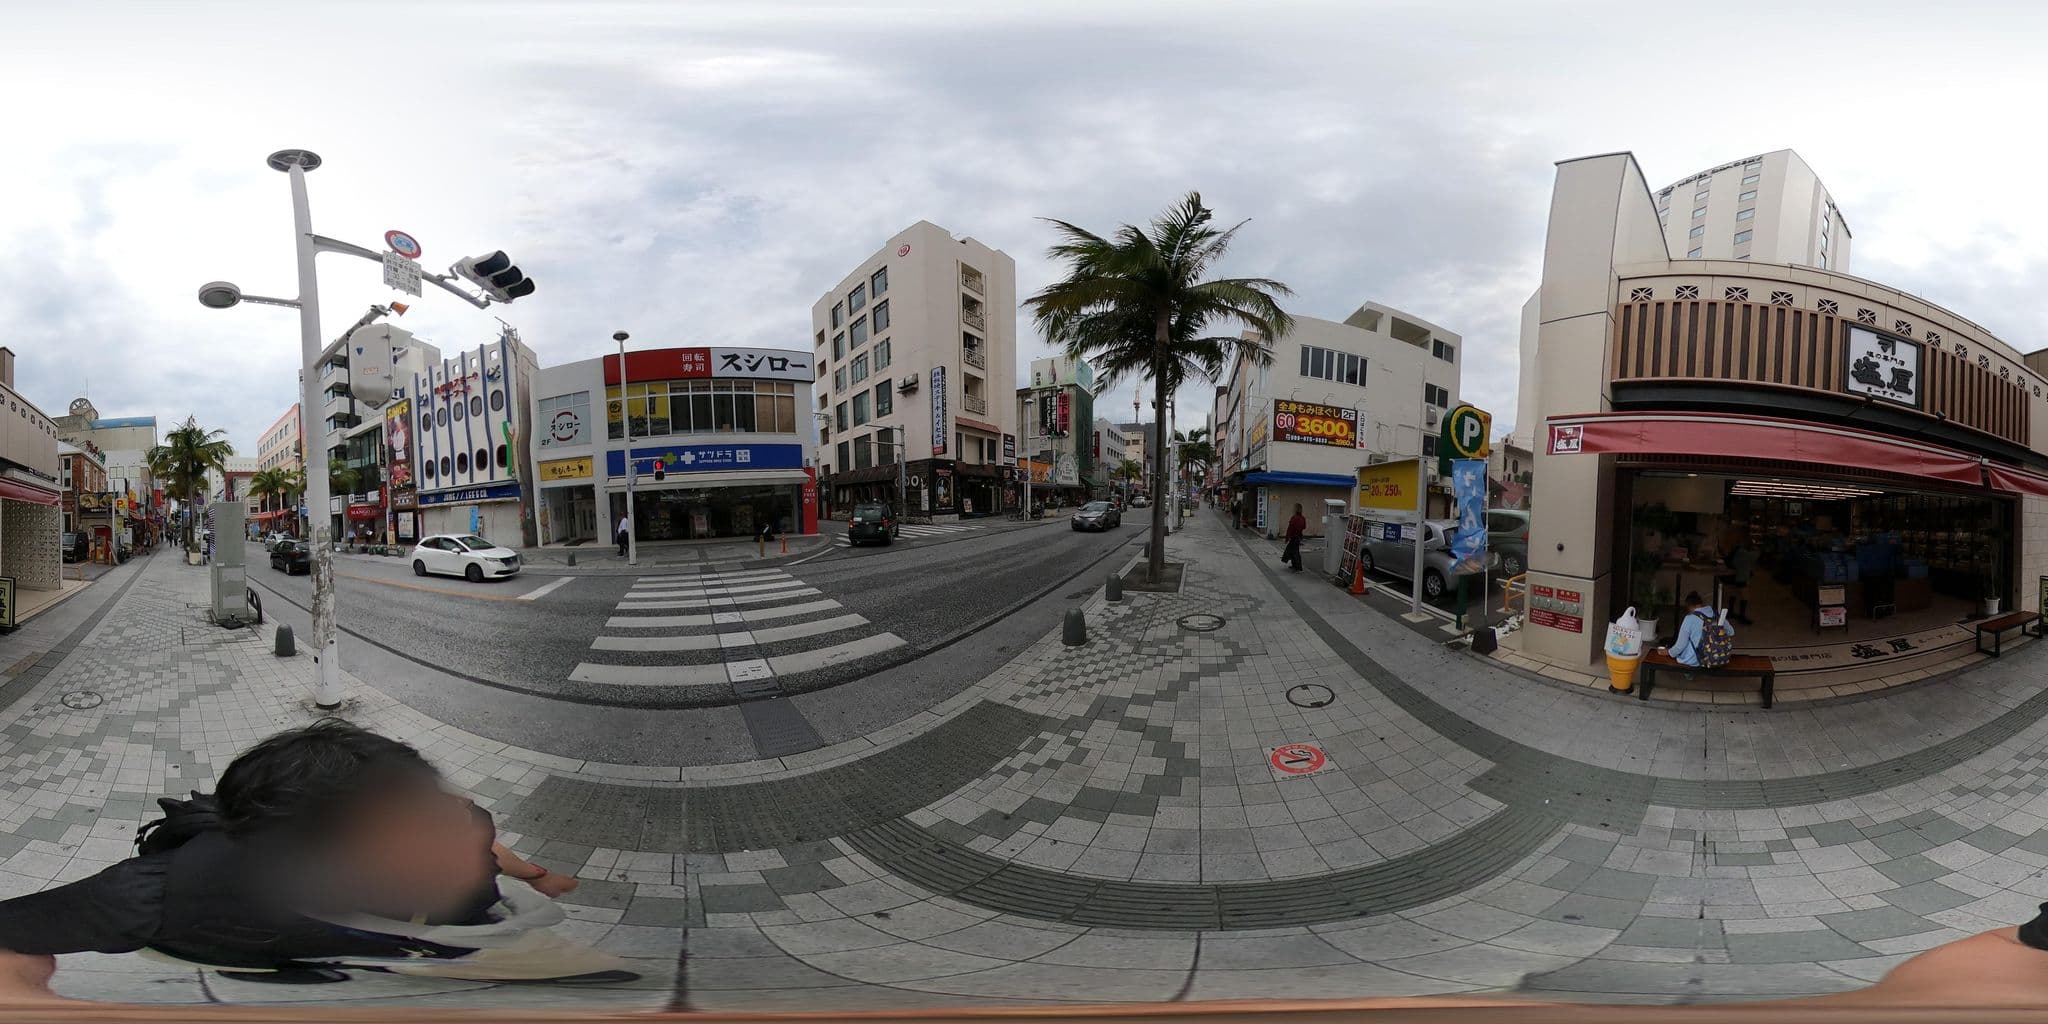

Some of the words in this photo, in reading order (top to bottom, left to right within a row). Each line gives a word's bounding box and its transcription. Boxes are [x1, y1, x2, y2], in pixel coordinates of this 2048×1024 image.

[682, 353, 705, 362] 回転
[719, 353, 807, 372] スシロー
[683, 363, 705, 373] 寿司
[1278, 401, 1340, 418] 全身もみほぐし
[1343, 410, 1355, 419] 2F
[549, 421, 581, 432] スシロー
[1463, 415, 1480, 448] P
[541, 438, 552, 446] 2F
[698, 450, 732, 459] サツドラ
